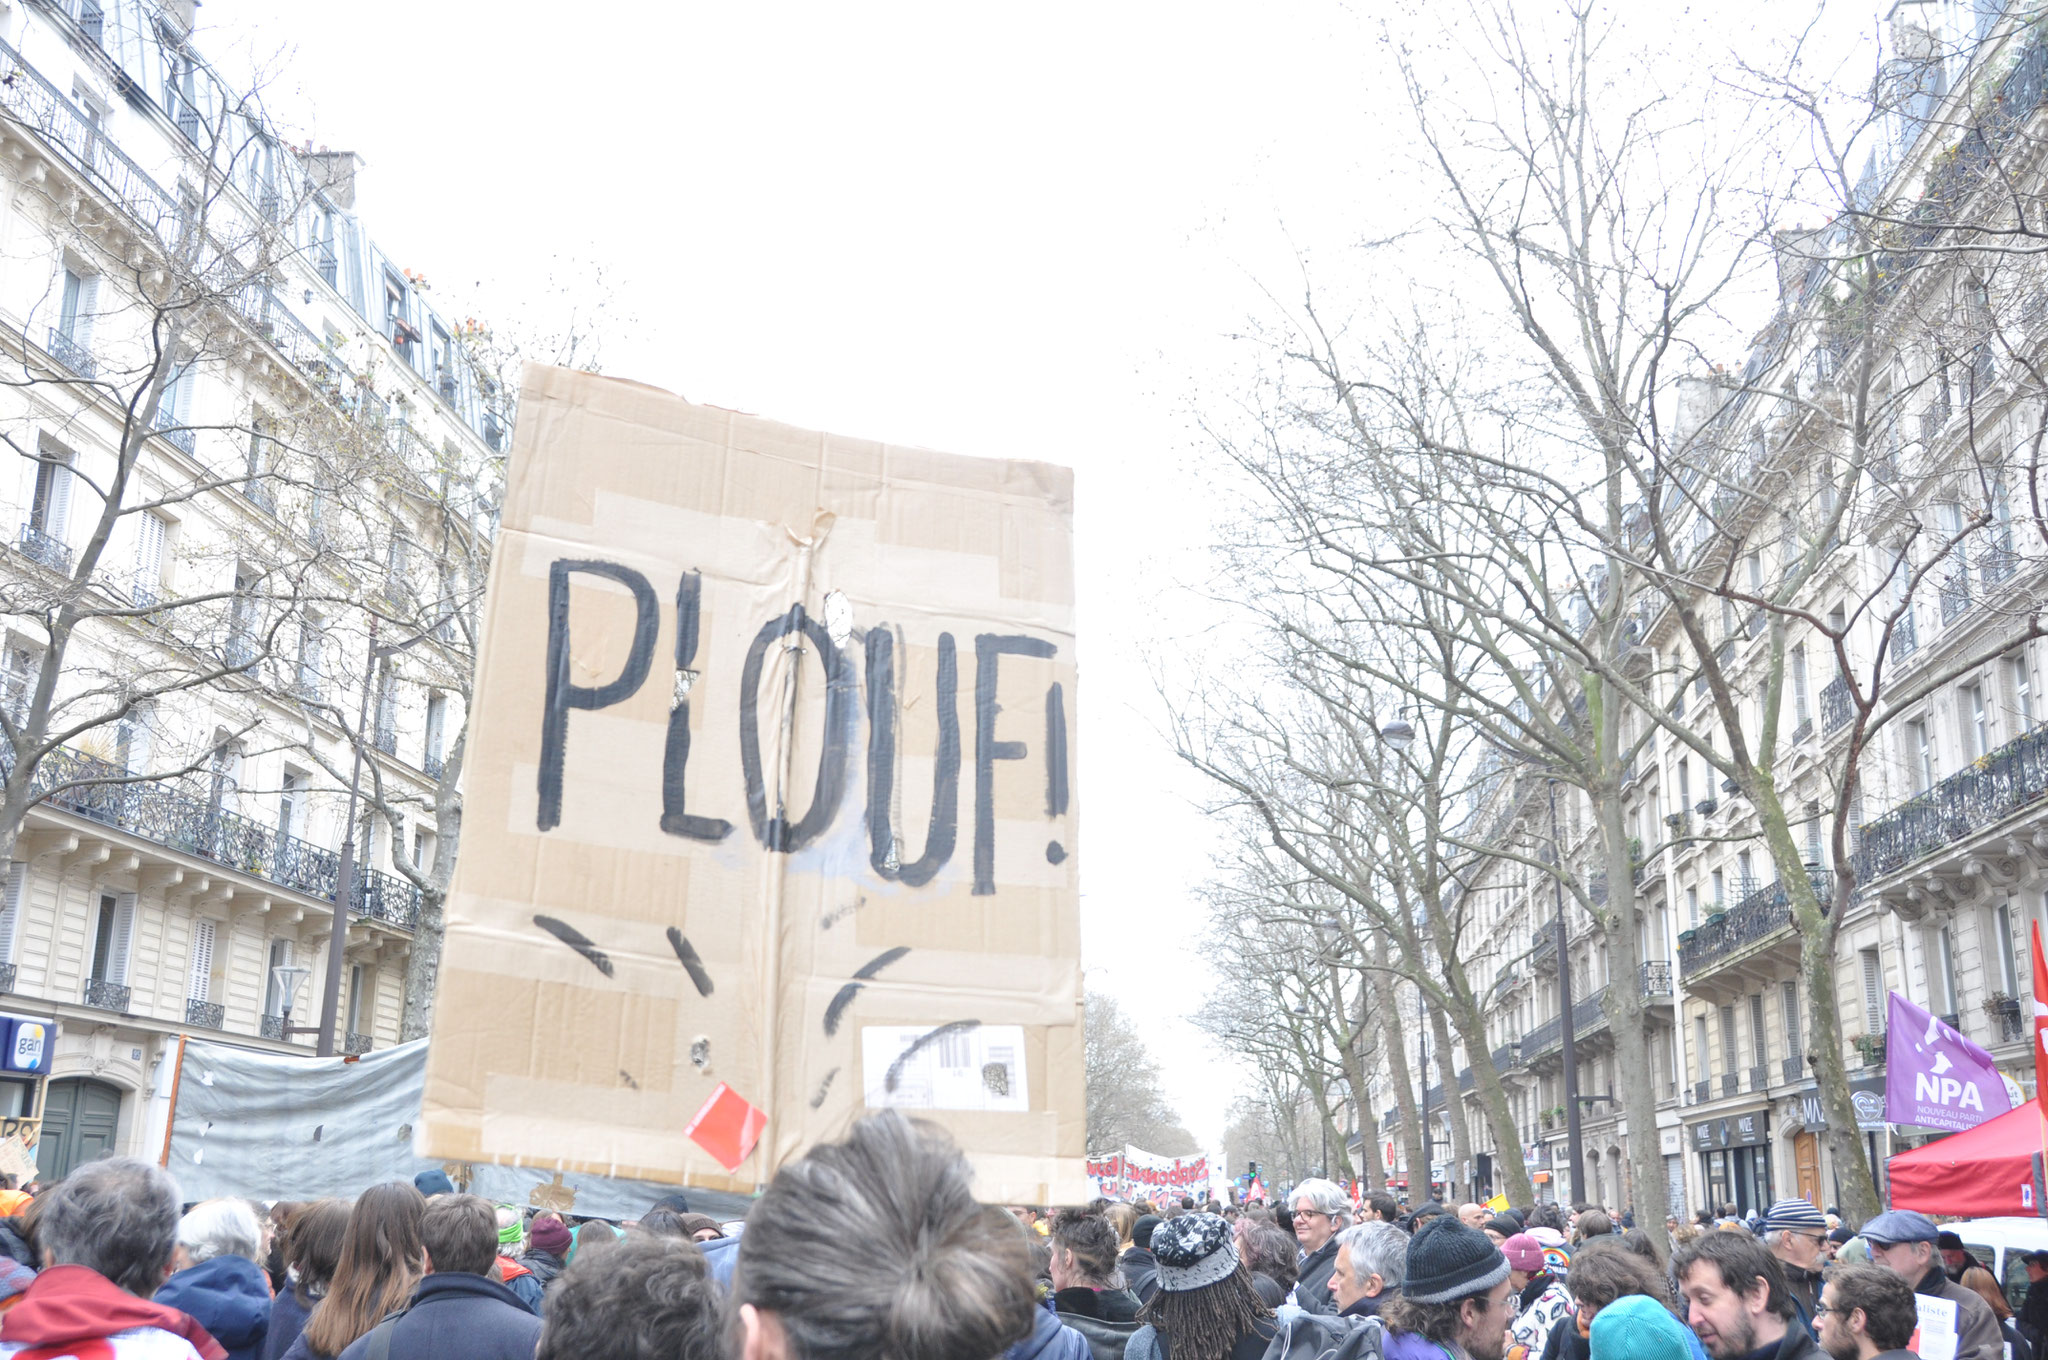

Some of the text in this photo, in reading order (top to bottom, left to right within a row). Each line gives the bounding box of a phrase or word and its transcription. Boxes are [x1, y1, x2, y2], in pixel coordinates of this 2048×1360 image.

[537, 557, 1070, 896] PLOUF!
[18, 1037, 41, 1055] gan
[1915, 1072, 1984, 1112] NPA
[1914, 1114, 1977, 1130] ANTICAPITALIS
[1917, 1105, 1983, 1124] NOUVEAU PARTI
